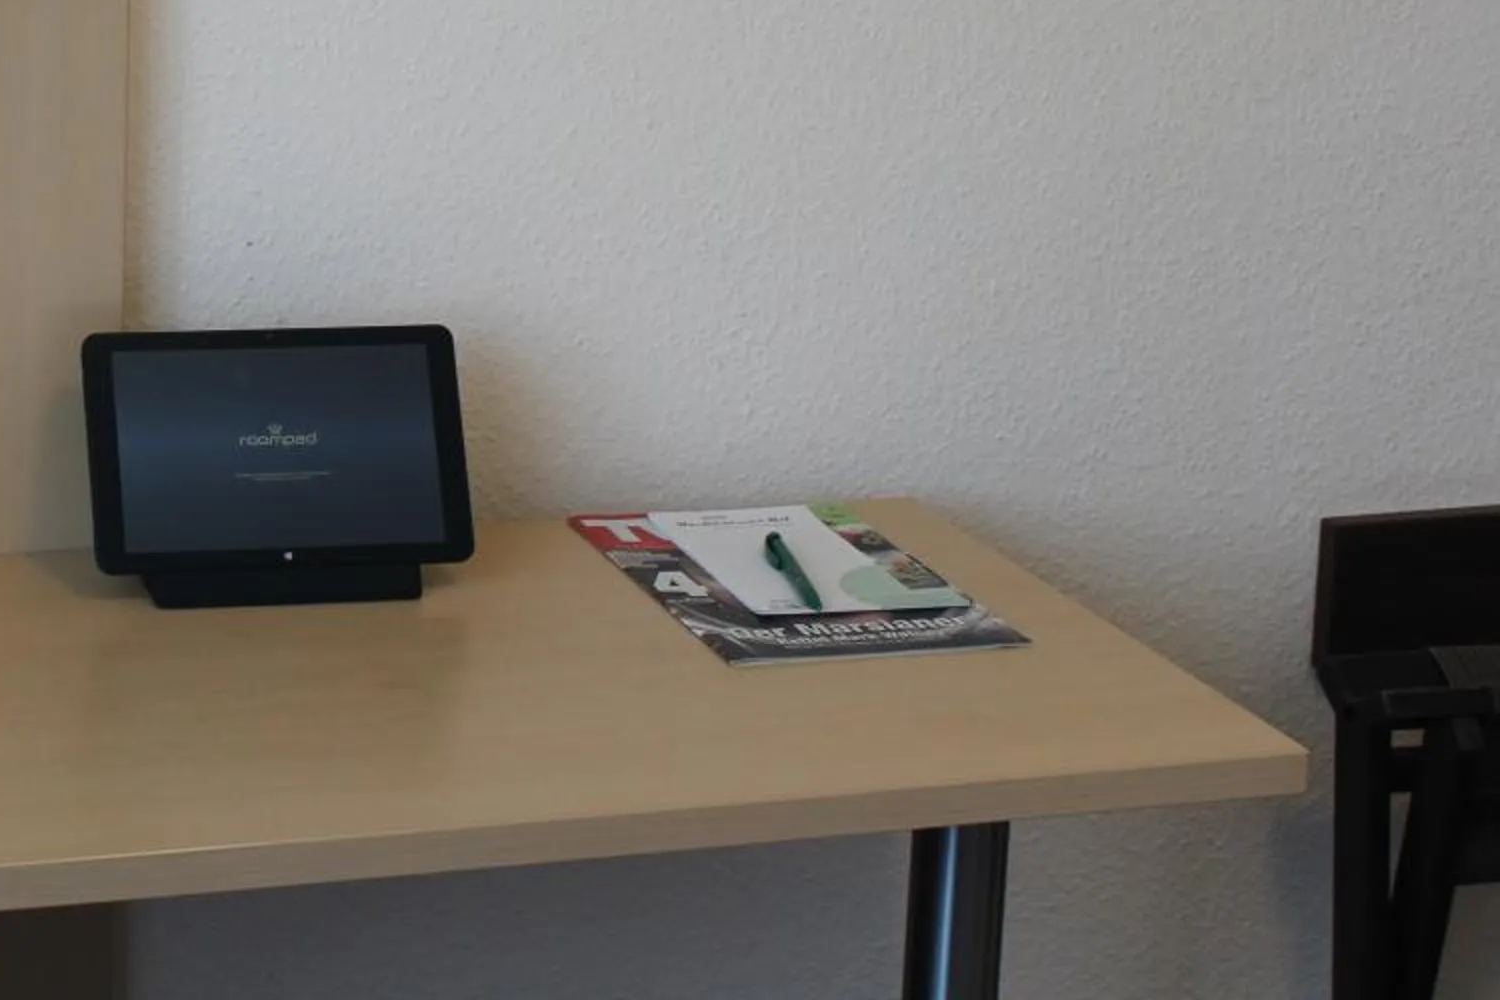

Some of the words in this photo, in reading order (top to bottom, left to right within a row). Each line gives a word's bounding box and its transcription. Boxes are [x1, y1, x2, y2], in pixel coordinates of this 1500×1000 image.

[239, 430, 317, 447] roompad
[730, 625, 788, 640] Der
[795, 614, 968, 638] Marsianer
